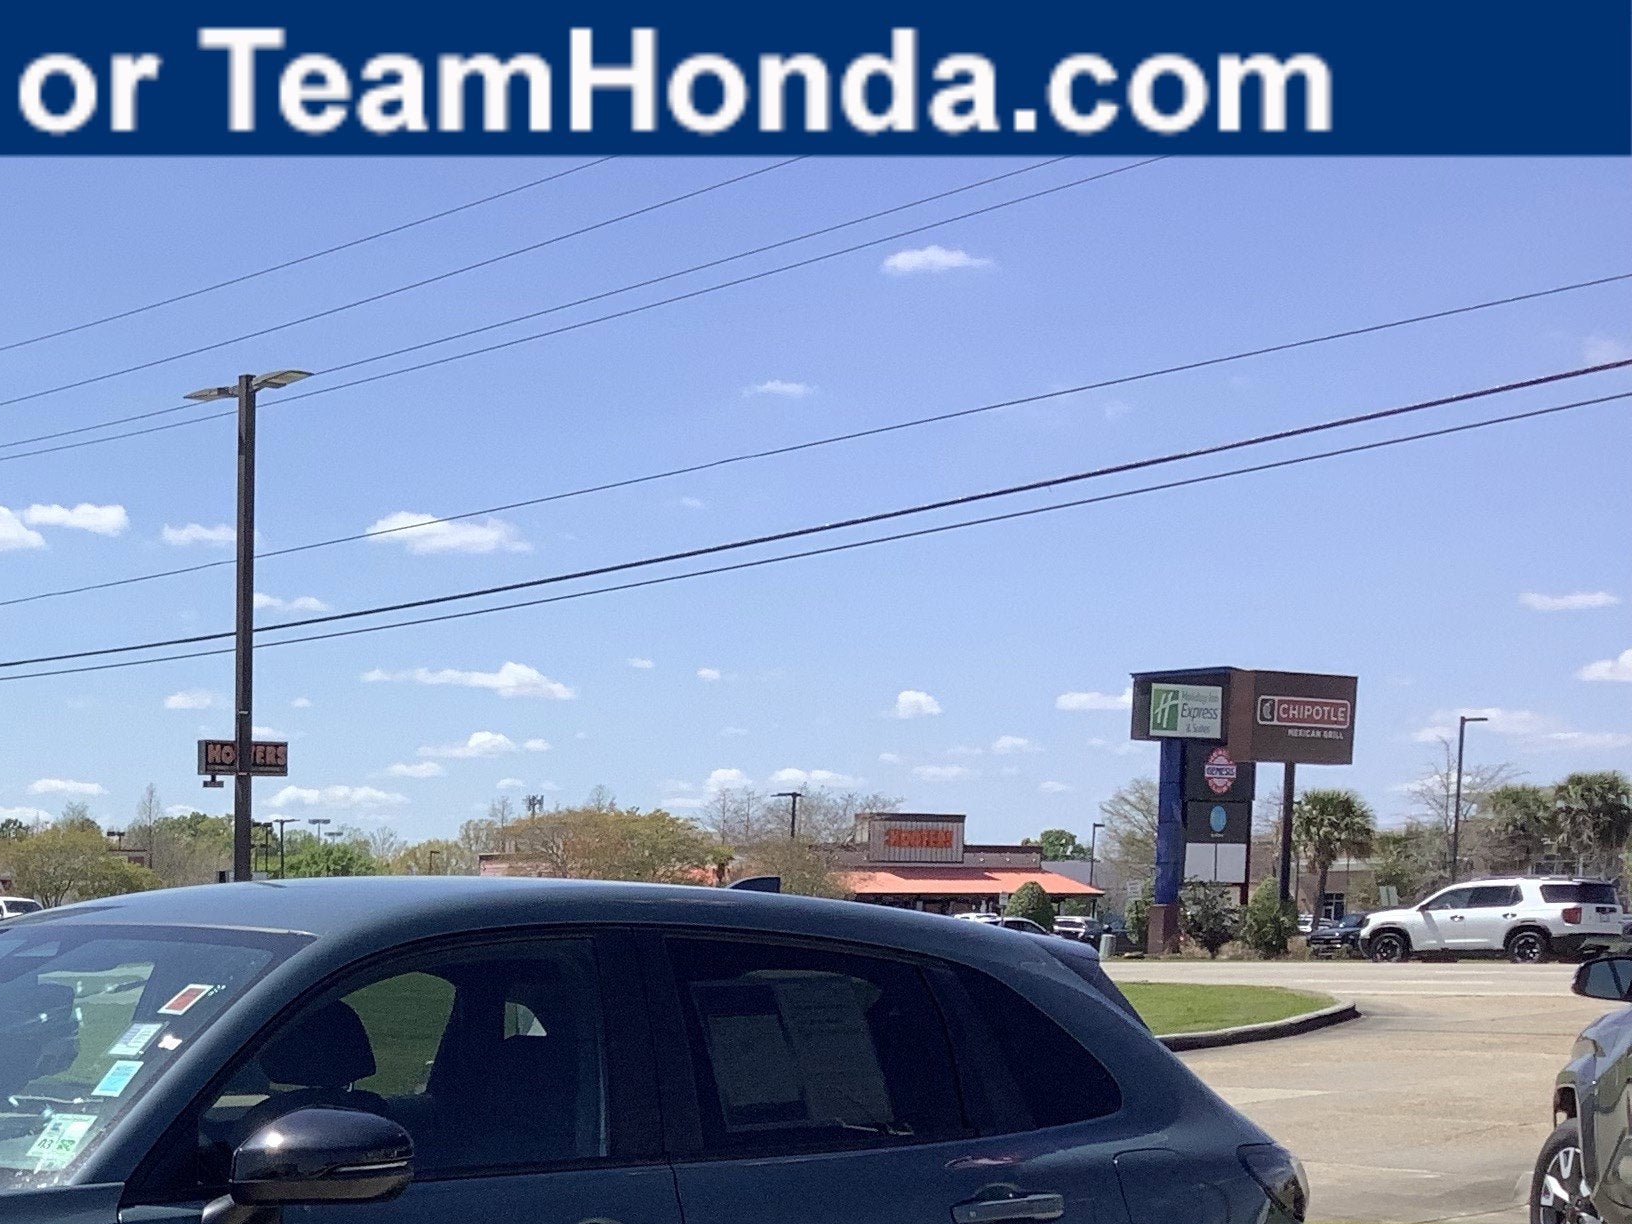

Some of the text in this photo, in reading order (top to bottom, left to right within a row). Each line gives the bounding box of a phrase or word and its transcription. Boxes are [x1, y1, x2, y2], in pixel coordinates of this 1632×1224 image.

[1181, 702, 1219, 720] Express
[1279, 703, 1347, 722] CHIPOTLE
[1288, 728, 1344, 740] MEXICAN GRILL
[207, 744, 286, 765] HOERS
